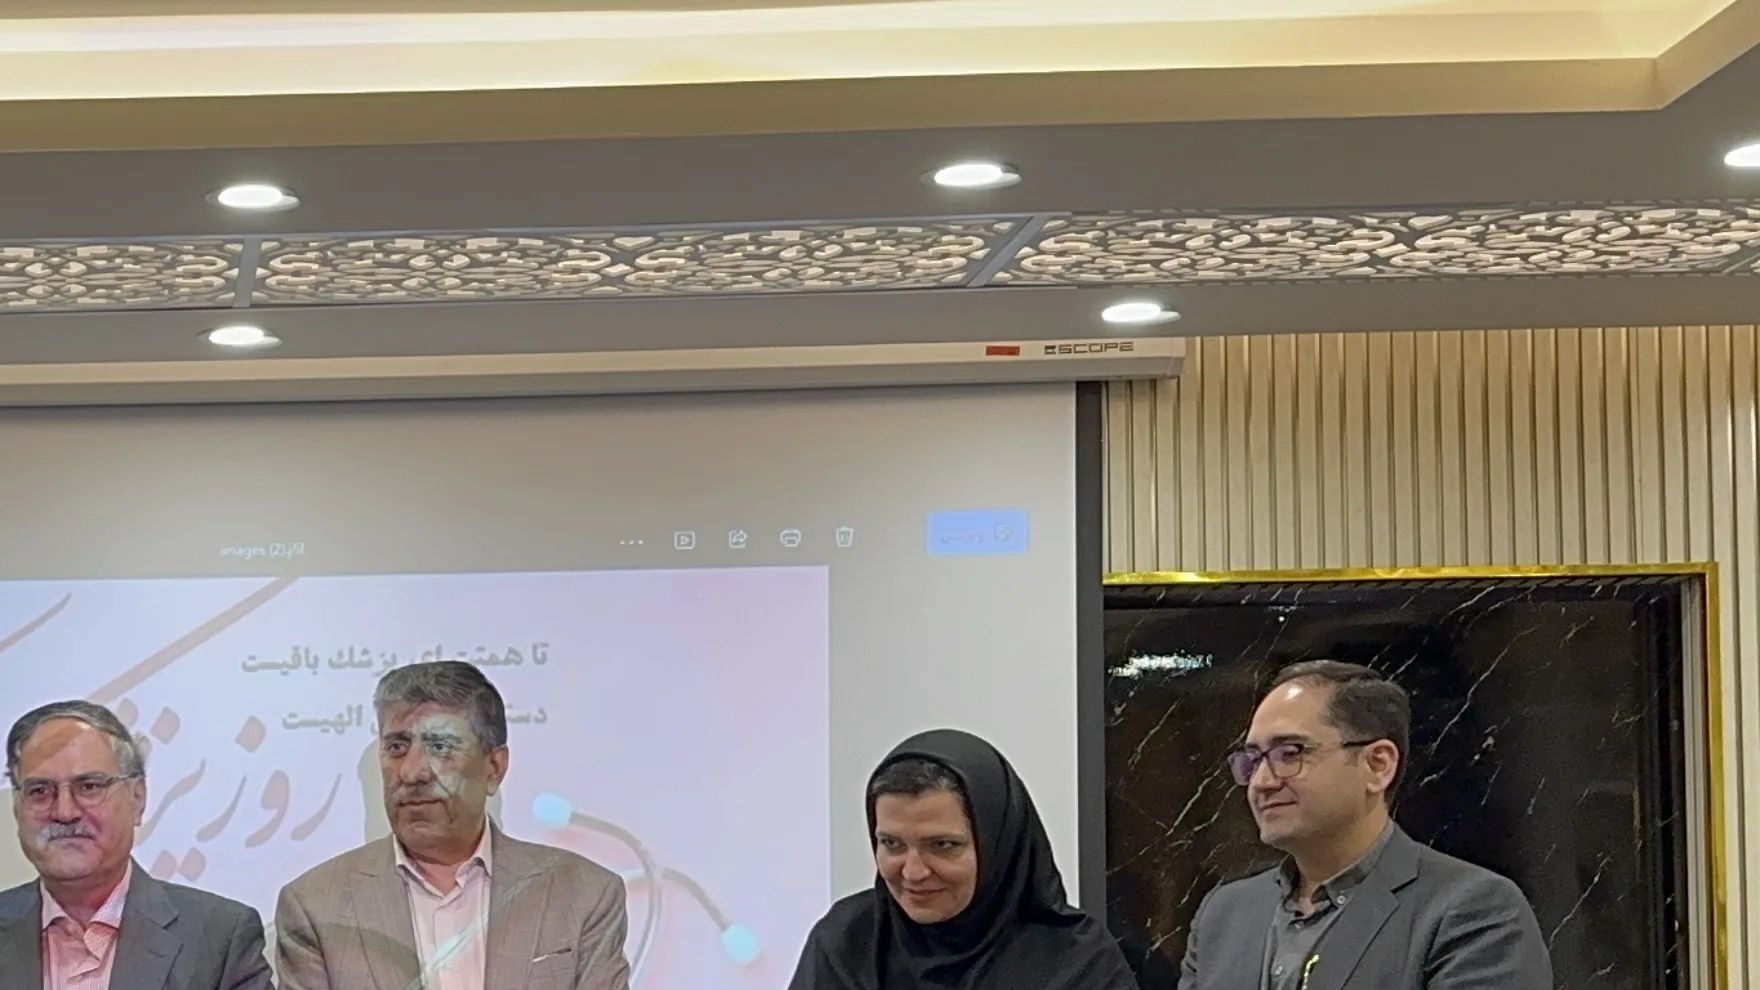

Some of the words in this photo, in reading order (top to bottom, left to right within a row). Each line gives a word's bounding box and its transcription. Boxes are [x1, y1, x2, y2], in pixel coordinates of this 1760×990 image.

[220, 544, 266, 560] images
[241, 645, 320, 676] باقیست
[532, 642, 549, 666] تا
[282, 703, 363, 736] الهیست
[195, 714, 342, 848] روز
